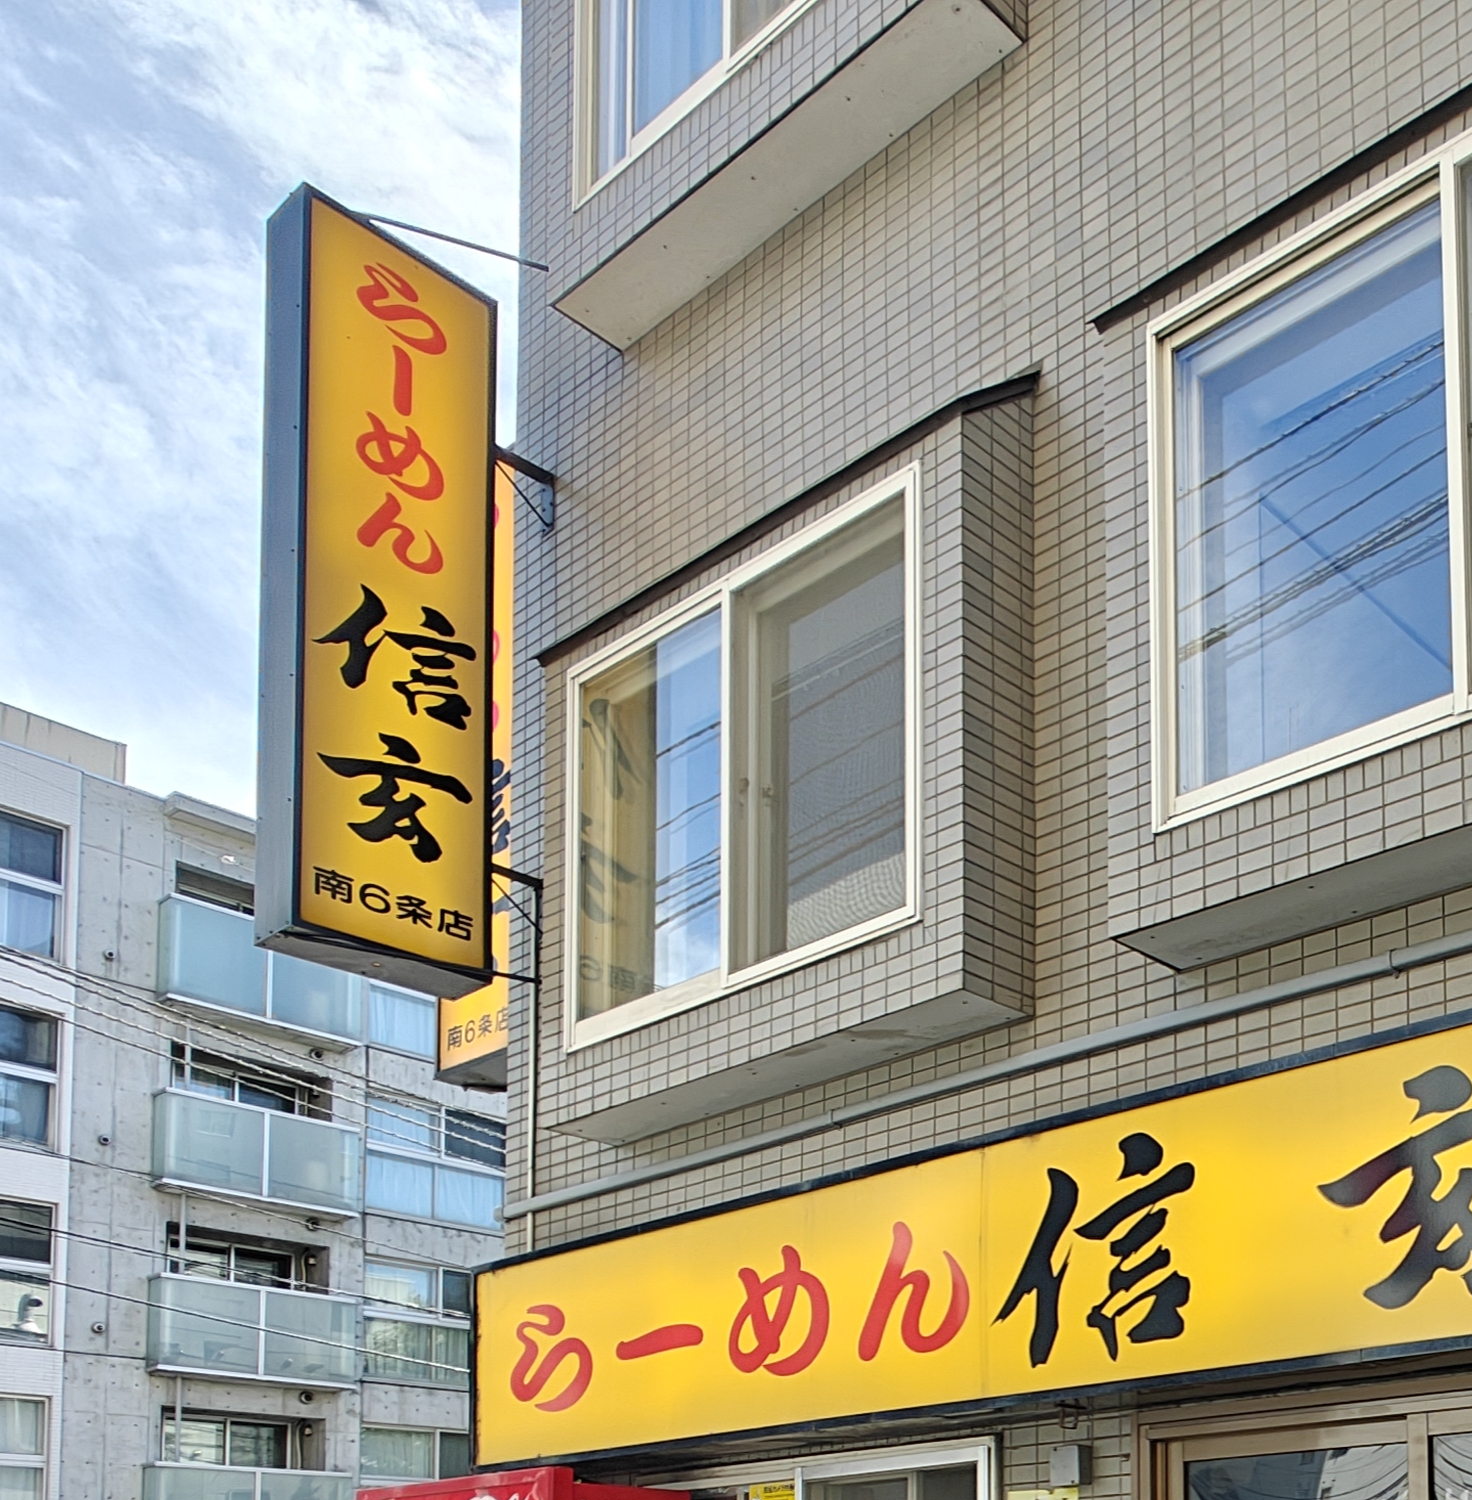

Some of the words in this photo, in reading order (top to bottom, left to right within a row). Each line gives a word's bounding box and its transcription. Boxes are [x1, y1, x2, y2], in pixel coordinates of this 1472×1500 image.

[355, 261, 447, 575] らーめん
[313, 584, 477, 864] 信玄
[312, 864, 475, 943] 南6条店
[509, 1222, 971, 1411] らーめん
